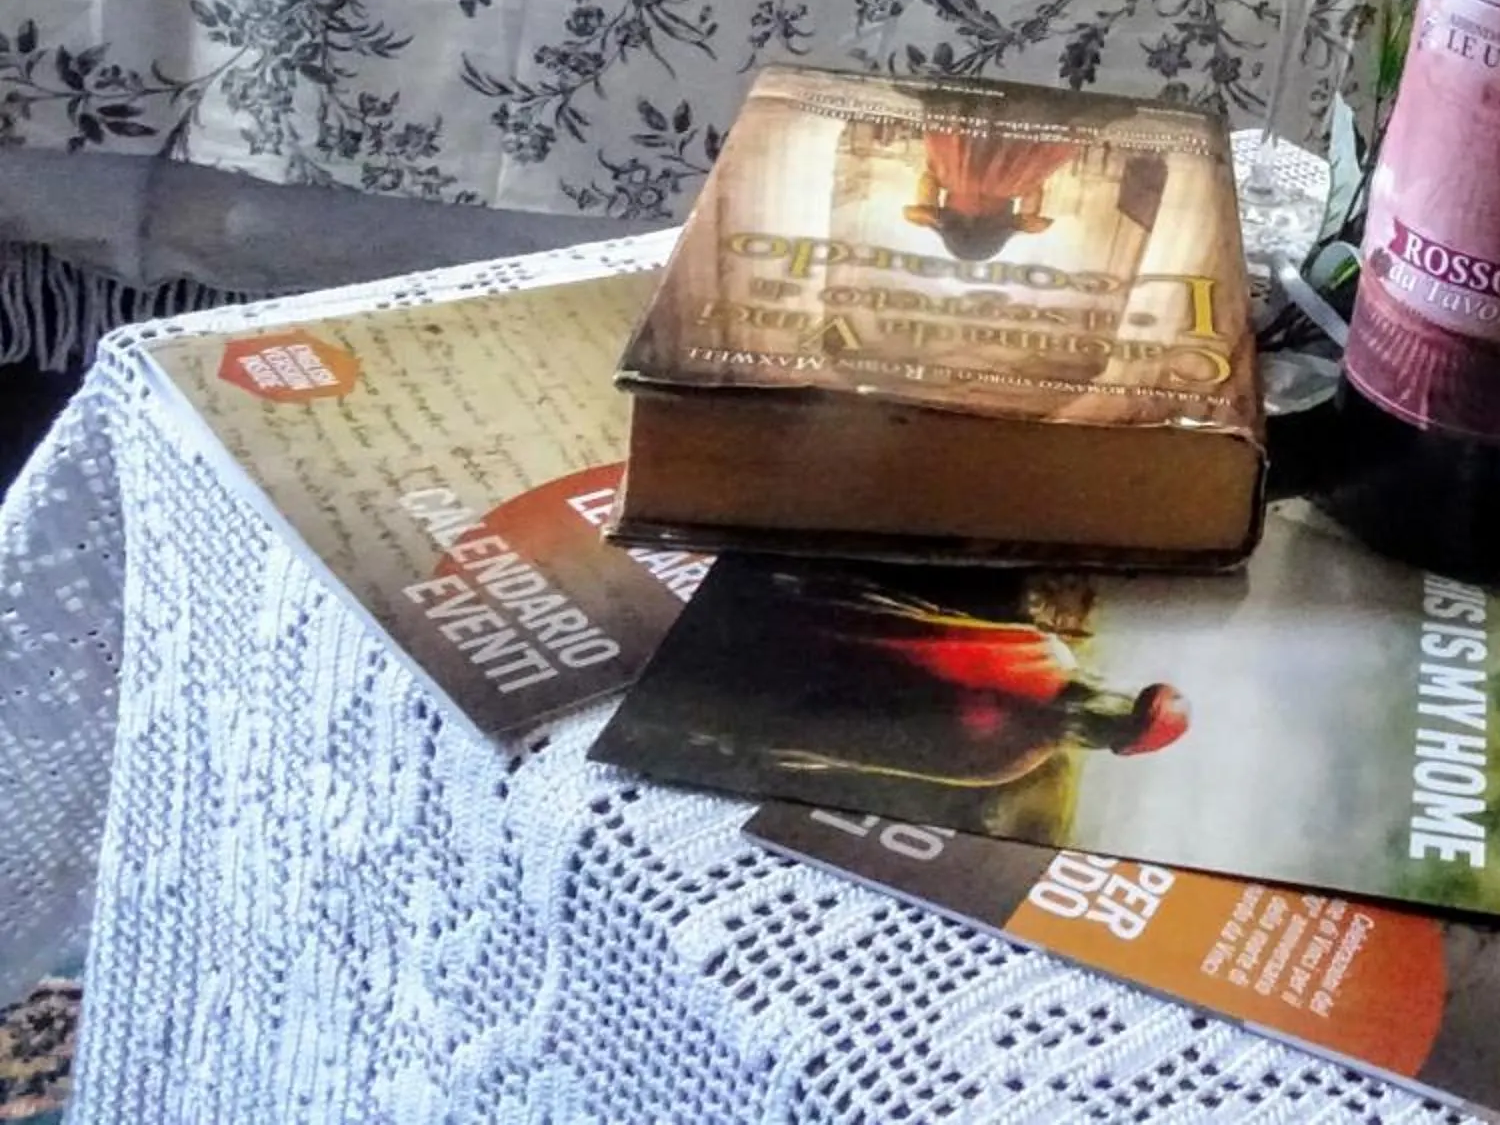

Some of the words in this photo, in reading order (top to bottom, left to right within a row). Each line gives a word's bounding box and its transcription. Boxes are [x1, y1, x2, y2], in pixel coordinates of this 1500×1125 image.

[1447, 29, 1477, 60] LE
[729, 232, 1216, 338] Leonardo
[1389, 261, 1418, 292] da
[399, 488, 621, 669] CALENDARIO
[1423, 572, 1486, 625] HIS
[402, 574, 559, 694] EVENTI
[1421, 622, 1488, 663] IS
[1417, 662, 1488, 733] MY
[1408, 728, 1488, 869] HOME
